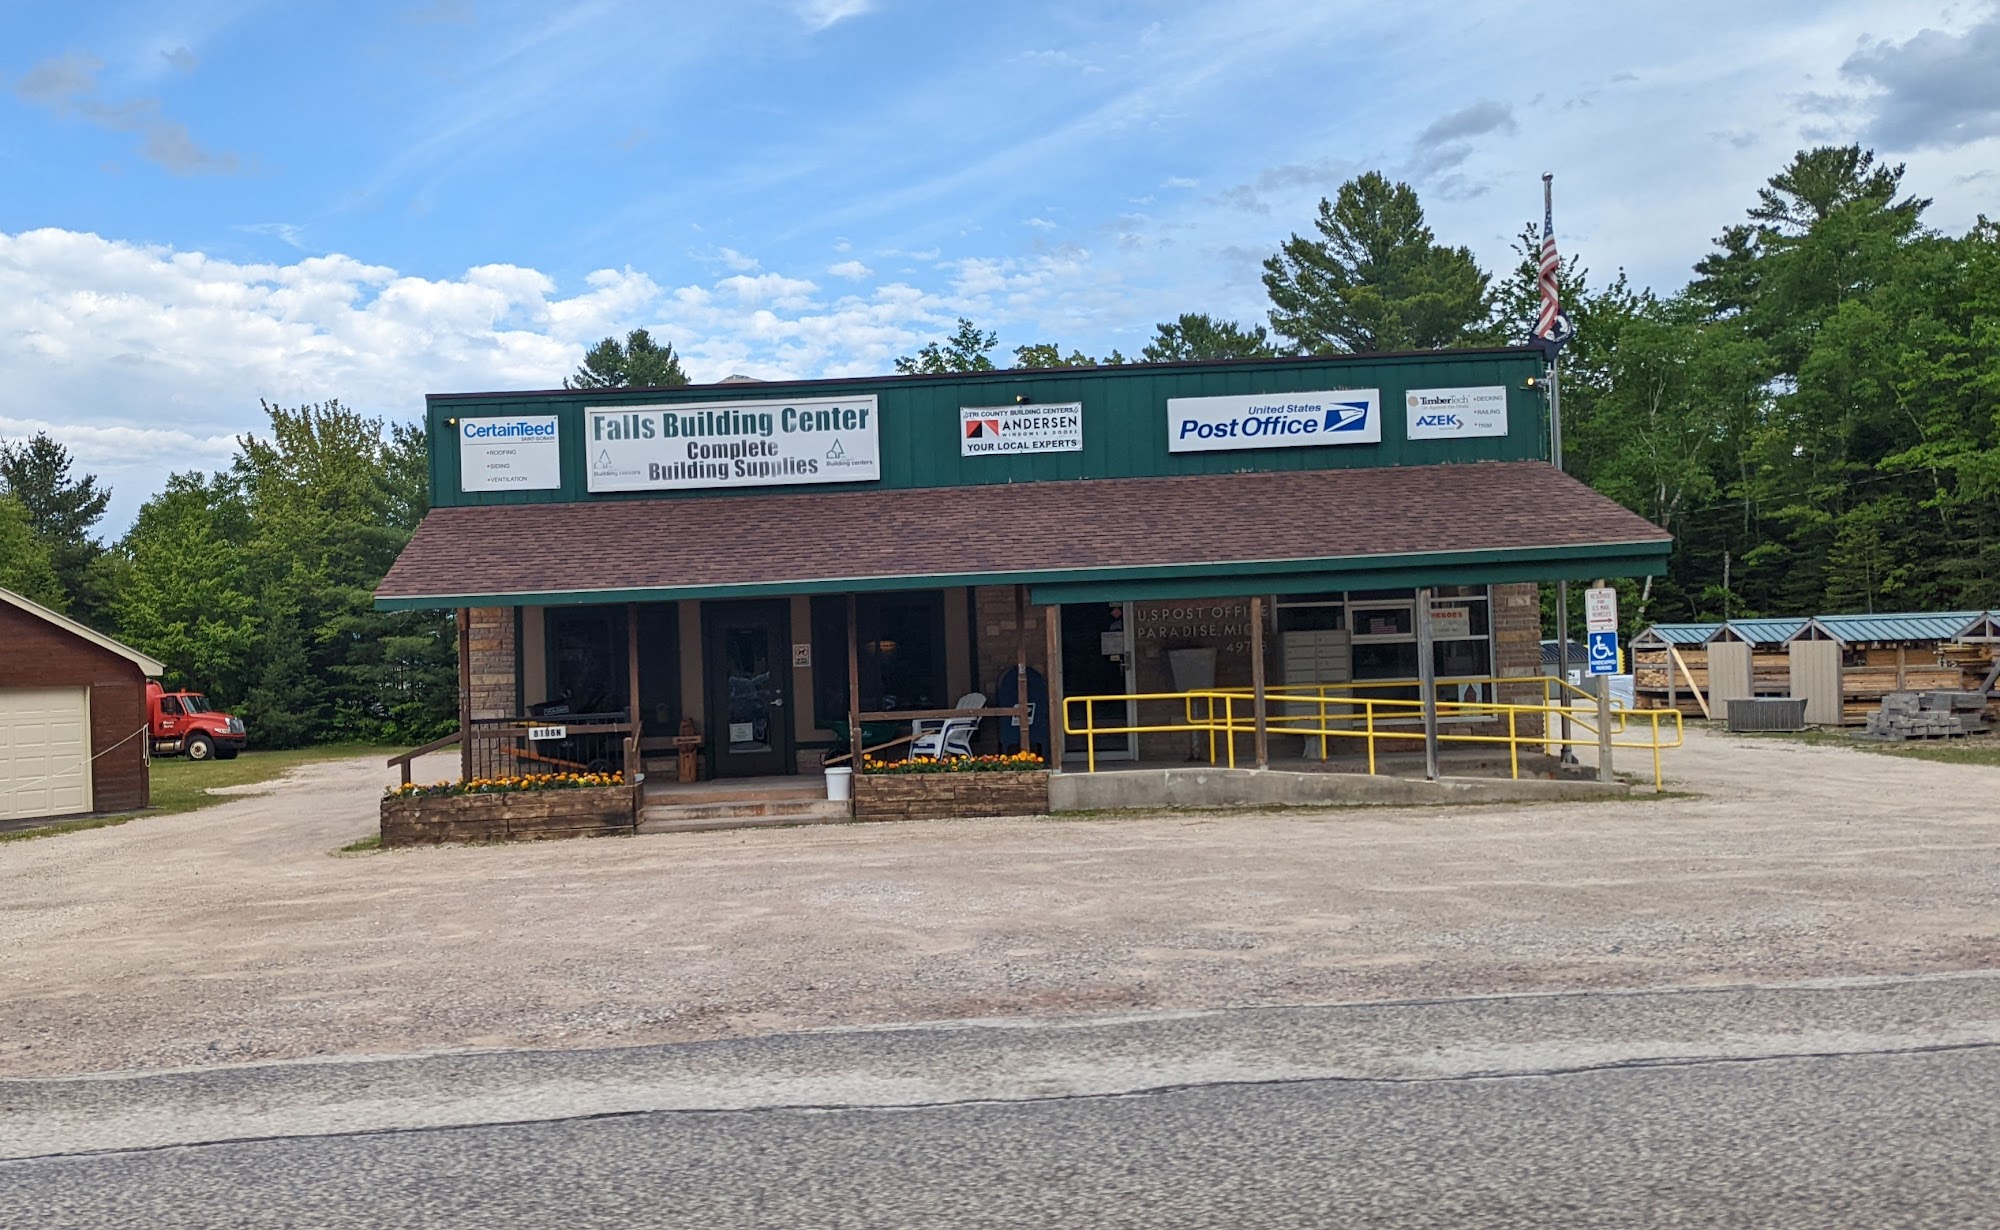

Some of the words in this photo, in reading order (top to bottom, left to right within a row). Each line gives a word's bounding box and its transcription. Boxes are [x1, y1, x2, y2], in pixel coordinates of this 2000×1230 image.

[1420, 395, 1469, 405] TimberTech
[1249, 404, 1285, 415] United
[1286, 404, 1322, 413] States
[594, 414, 656, 441] Falls
[663, 410, 773, 438] Building
[781, 407, 869, 433] Center
[1002, 416, 1078, 431] ANDERSEN
[1179, 419, 1239, 439] Post
[1241, 416, 1319, 437] Office
[1416, 414, 1457, 427] AZEK
[464, 421, 555, 438] CertainTeed
[687, 439, 779, 461] Complete
[967, 443, 995, 452] YOUR
[997, 441, 1030, 450] LOCAL
[1032, 439, 1077, 449] EXPERTS
[648, 461, 729, 481] Building
[734, 457, 819, 479] Supplies
[1211, 606, 1268, 618] OFFIE
